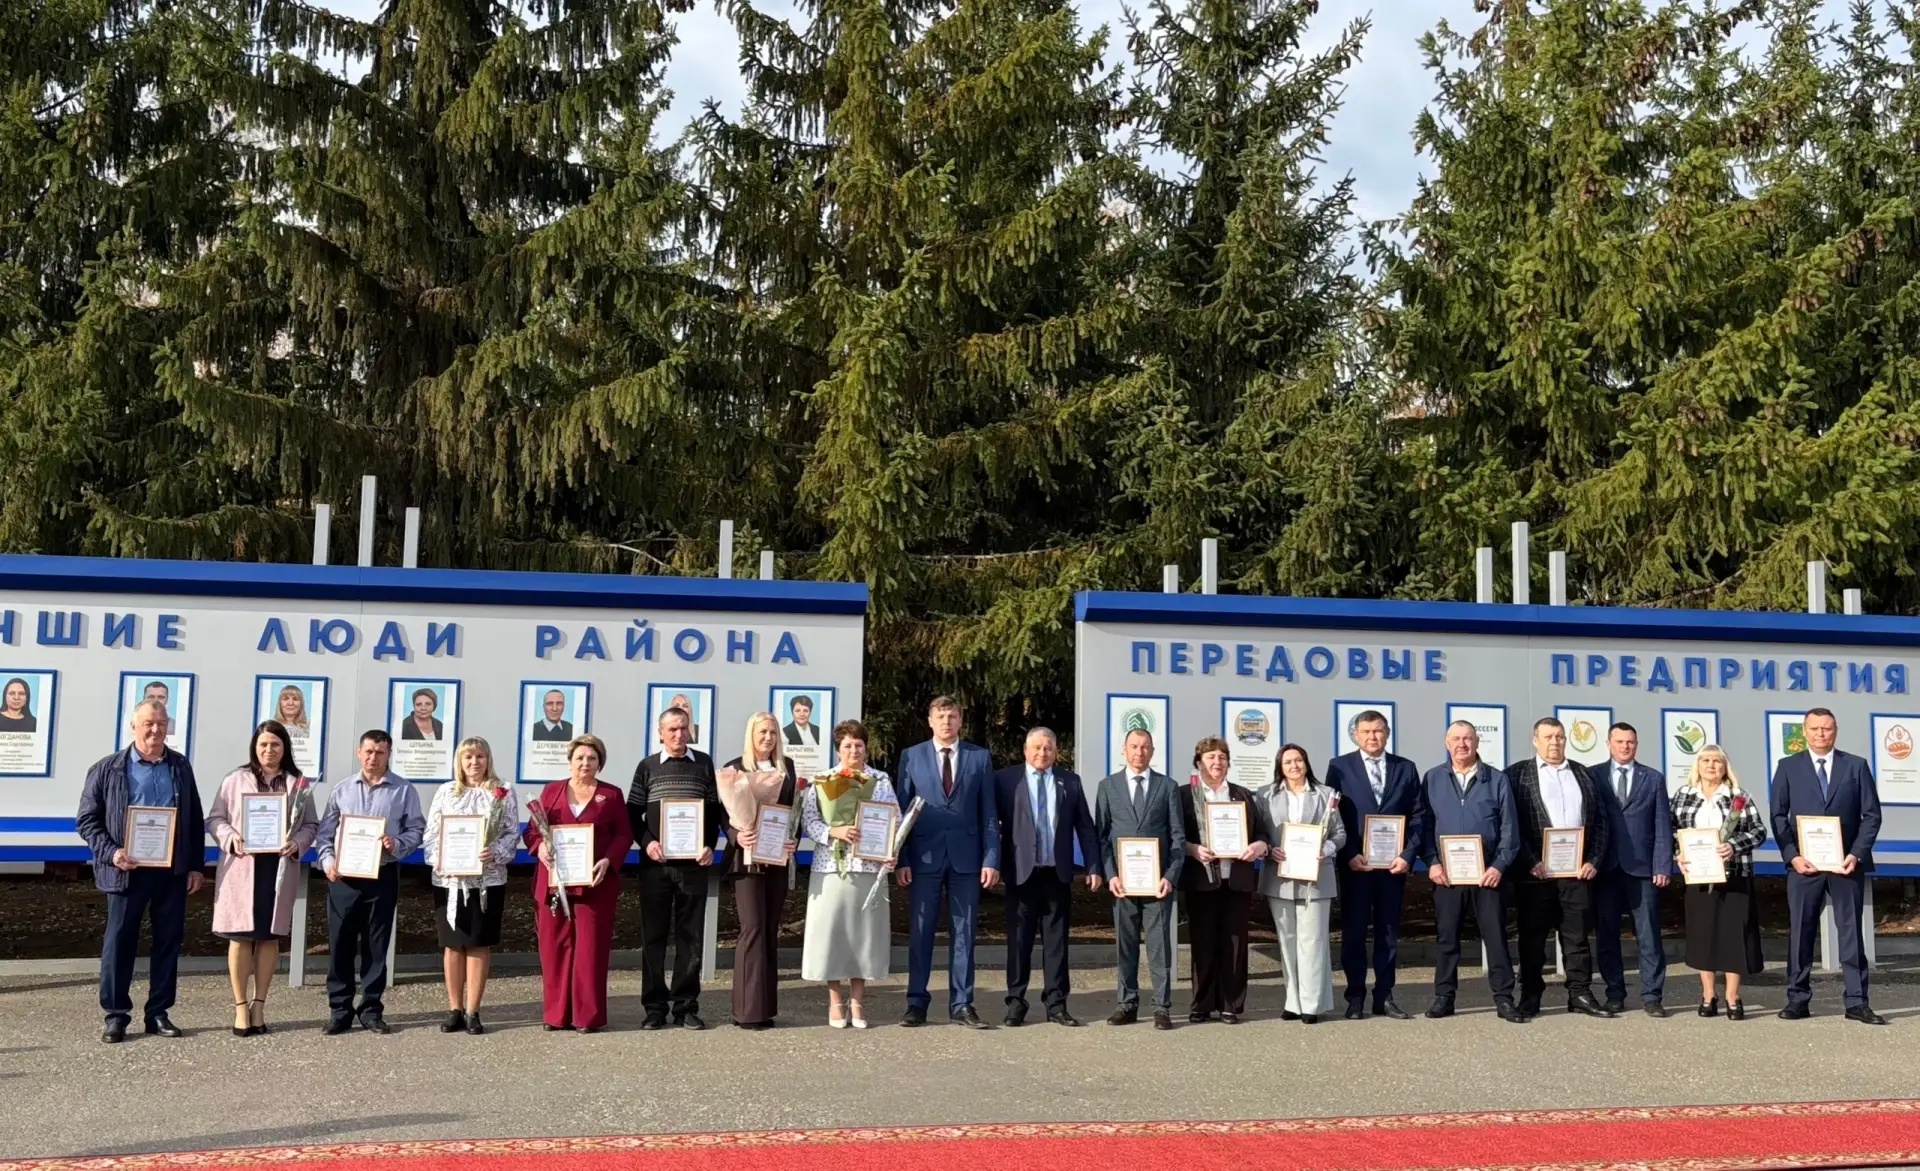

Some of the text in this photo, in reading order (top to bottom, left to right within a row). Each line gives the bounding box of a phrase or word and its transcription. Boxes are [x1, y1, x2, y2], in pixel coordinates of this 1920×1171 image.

[256, 616, 457, 661] ЛЮДИ
[535, 618, 801, 664] РАЙОНА
[1131, 640, 1907, 693] ПЕРЕДОВЫЕ ПРЕДПРИЯТИЯ
